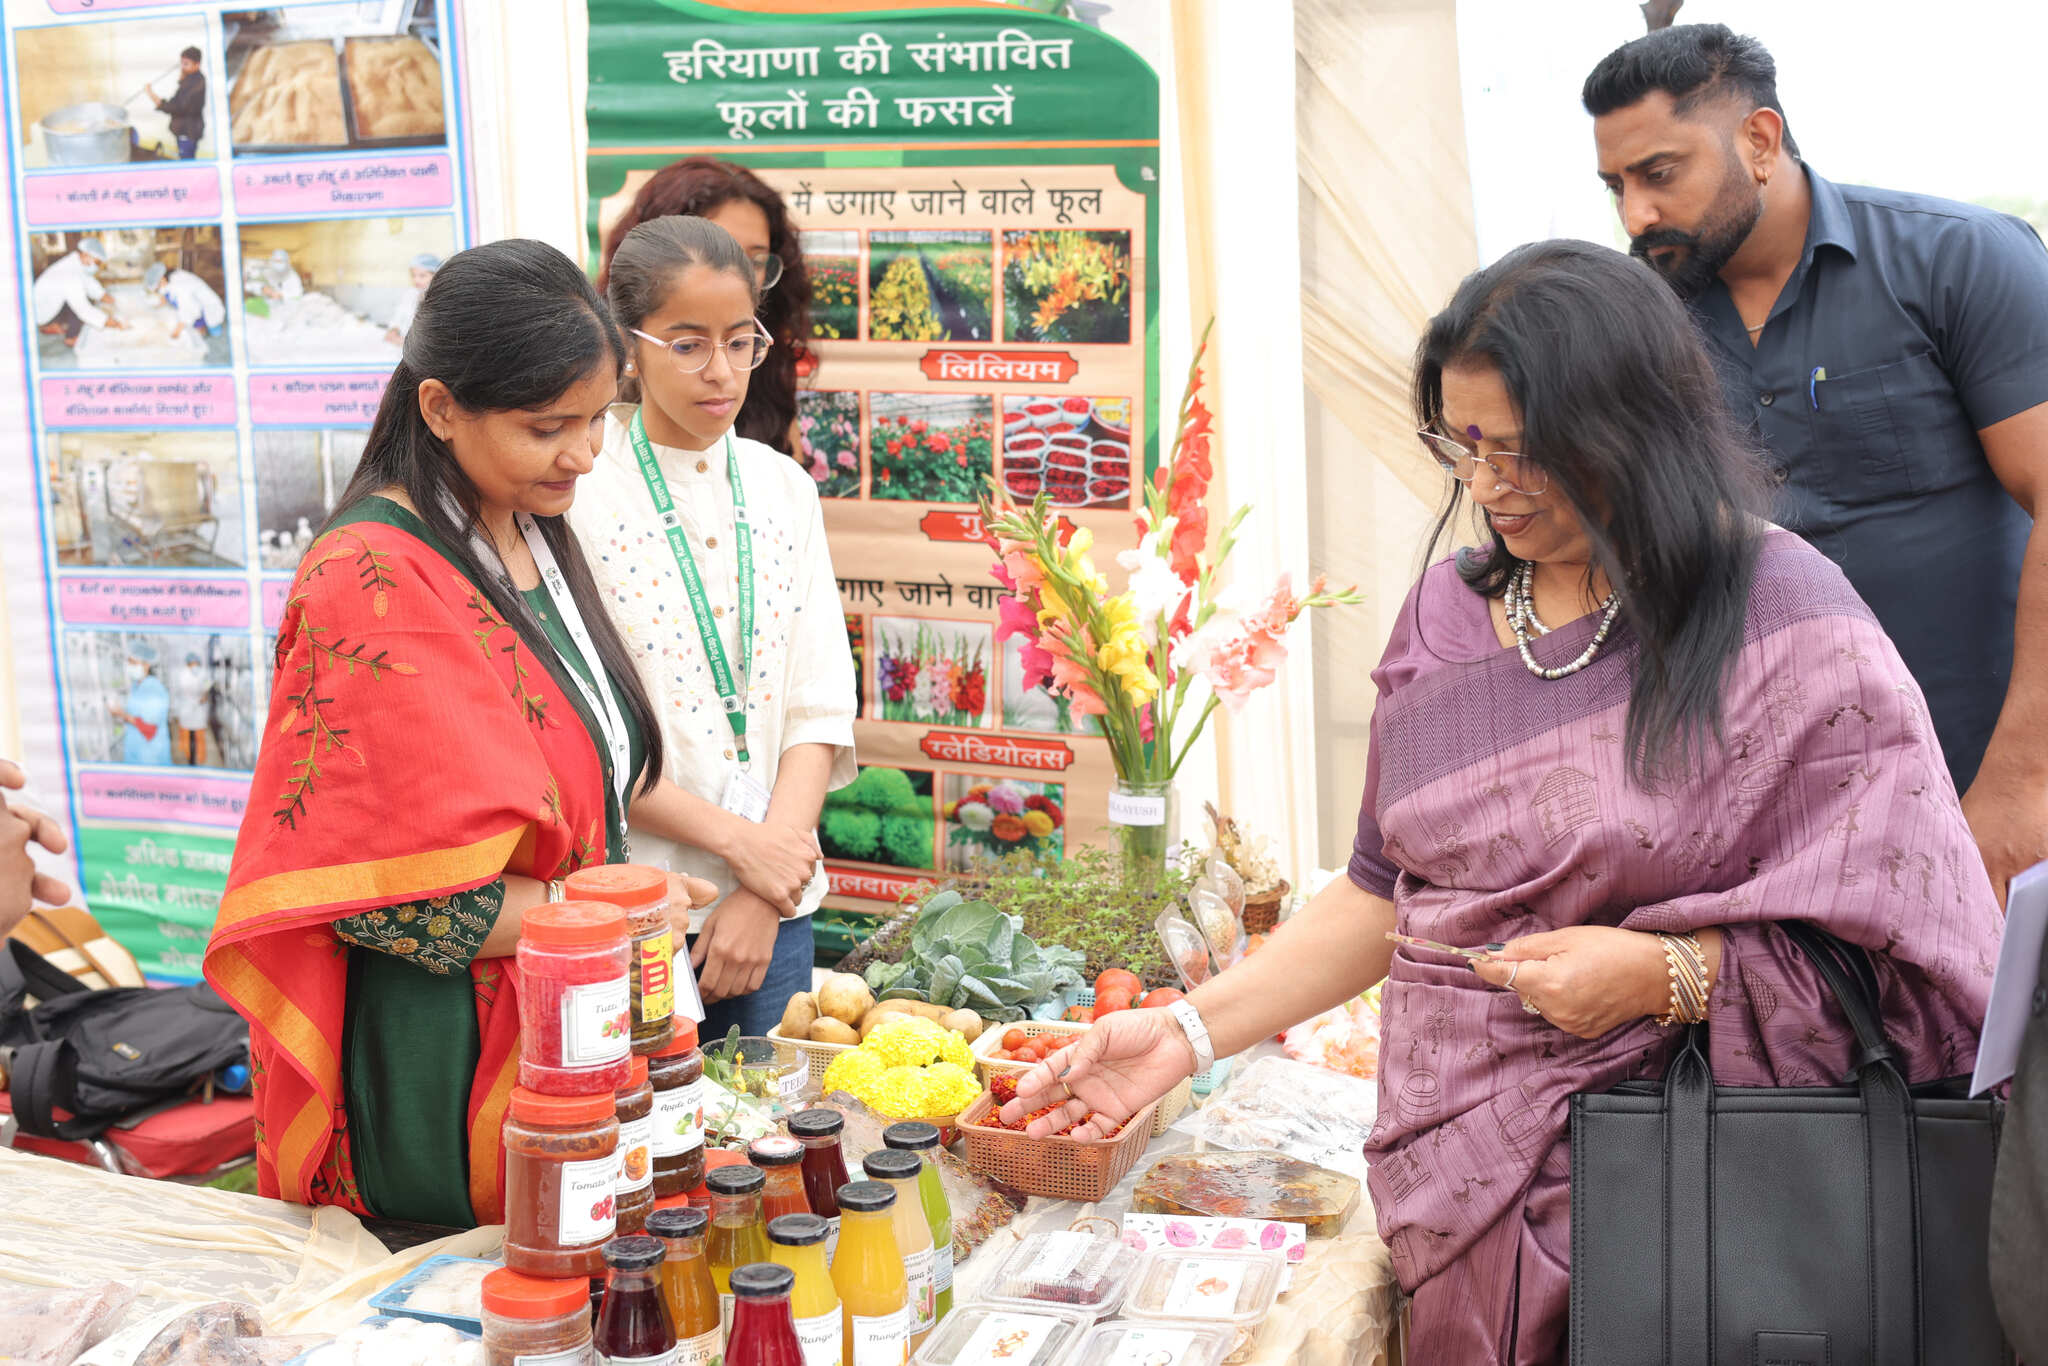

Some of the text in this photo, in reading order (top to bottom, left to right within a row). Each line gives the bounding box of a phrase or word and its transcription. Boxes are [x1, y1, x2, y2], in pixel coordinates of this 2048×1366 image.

[663, 28, 1073, 84] हरियाणा की संभावित
[716, 84, 1015, 140] फूलों की फसलें
[824, 189, 896, 220] उगाए
[907, 180, 966, 215] जाने
[978, 179, 1035, 215] वाले
[1047, 188, 1102, 223] फूल
[936, 352, 1062, 381] लिलियम
[836, 578, 884, 607] गाए
[894, 573, 952, 607] जाने
[928, 735, 1066, 768] ग्लेडियोलस
[571, 1179, 606, 1191] Tomato
[868, 1331, 902, 1342] Mango
